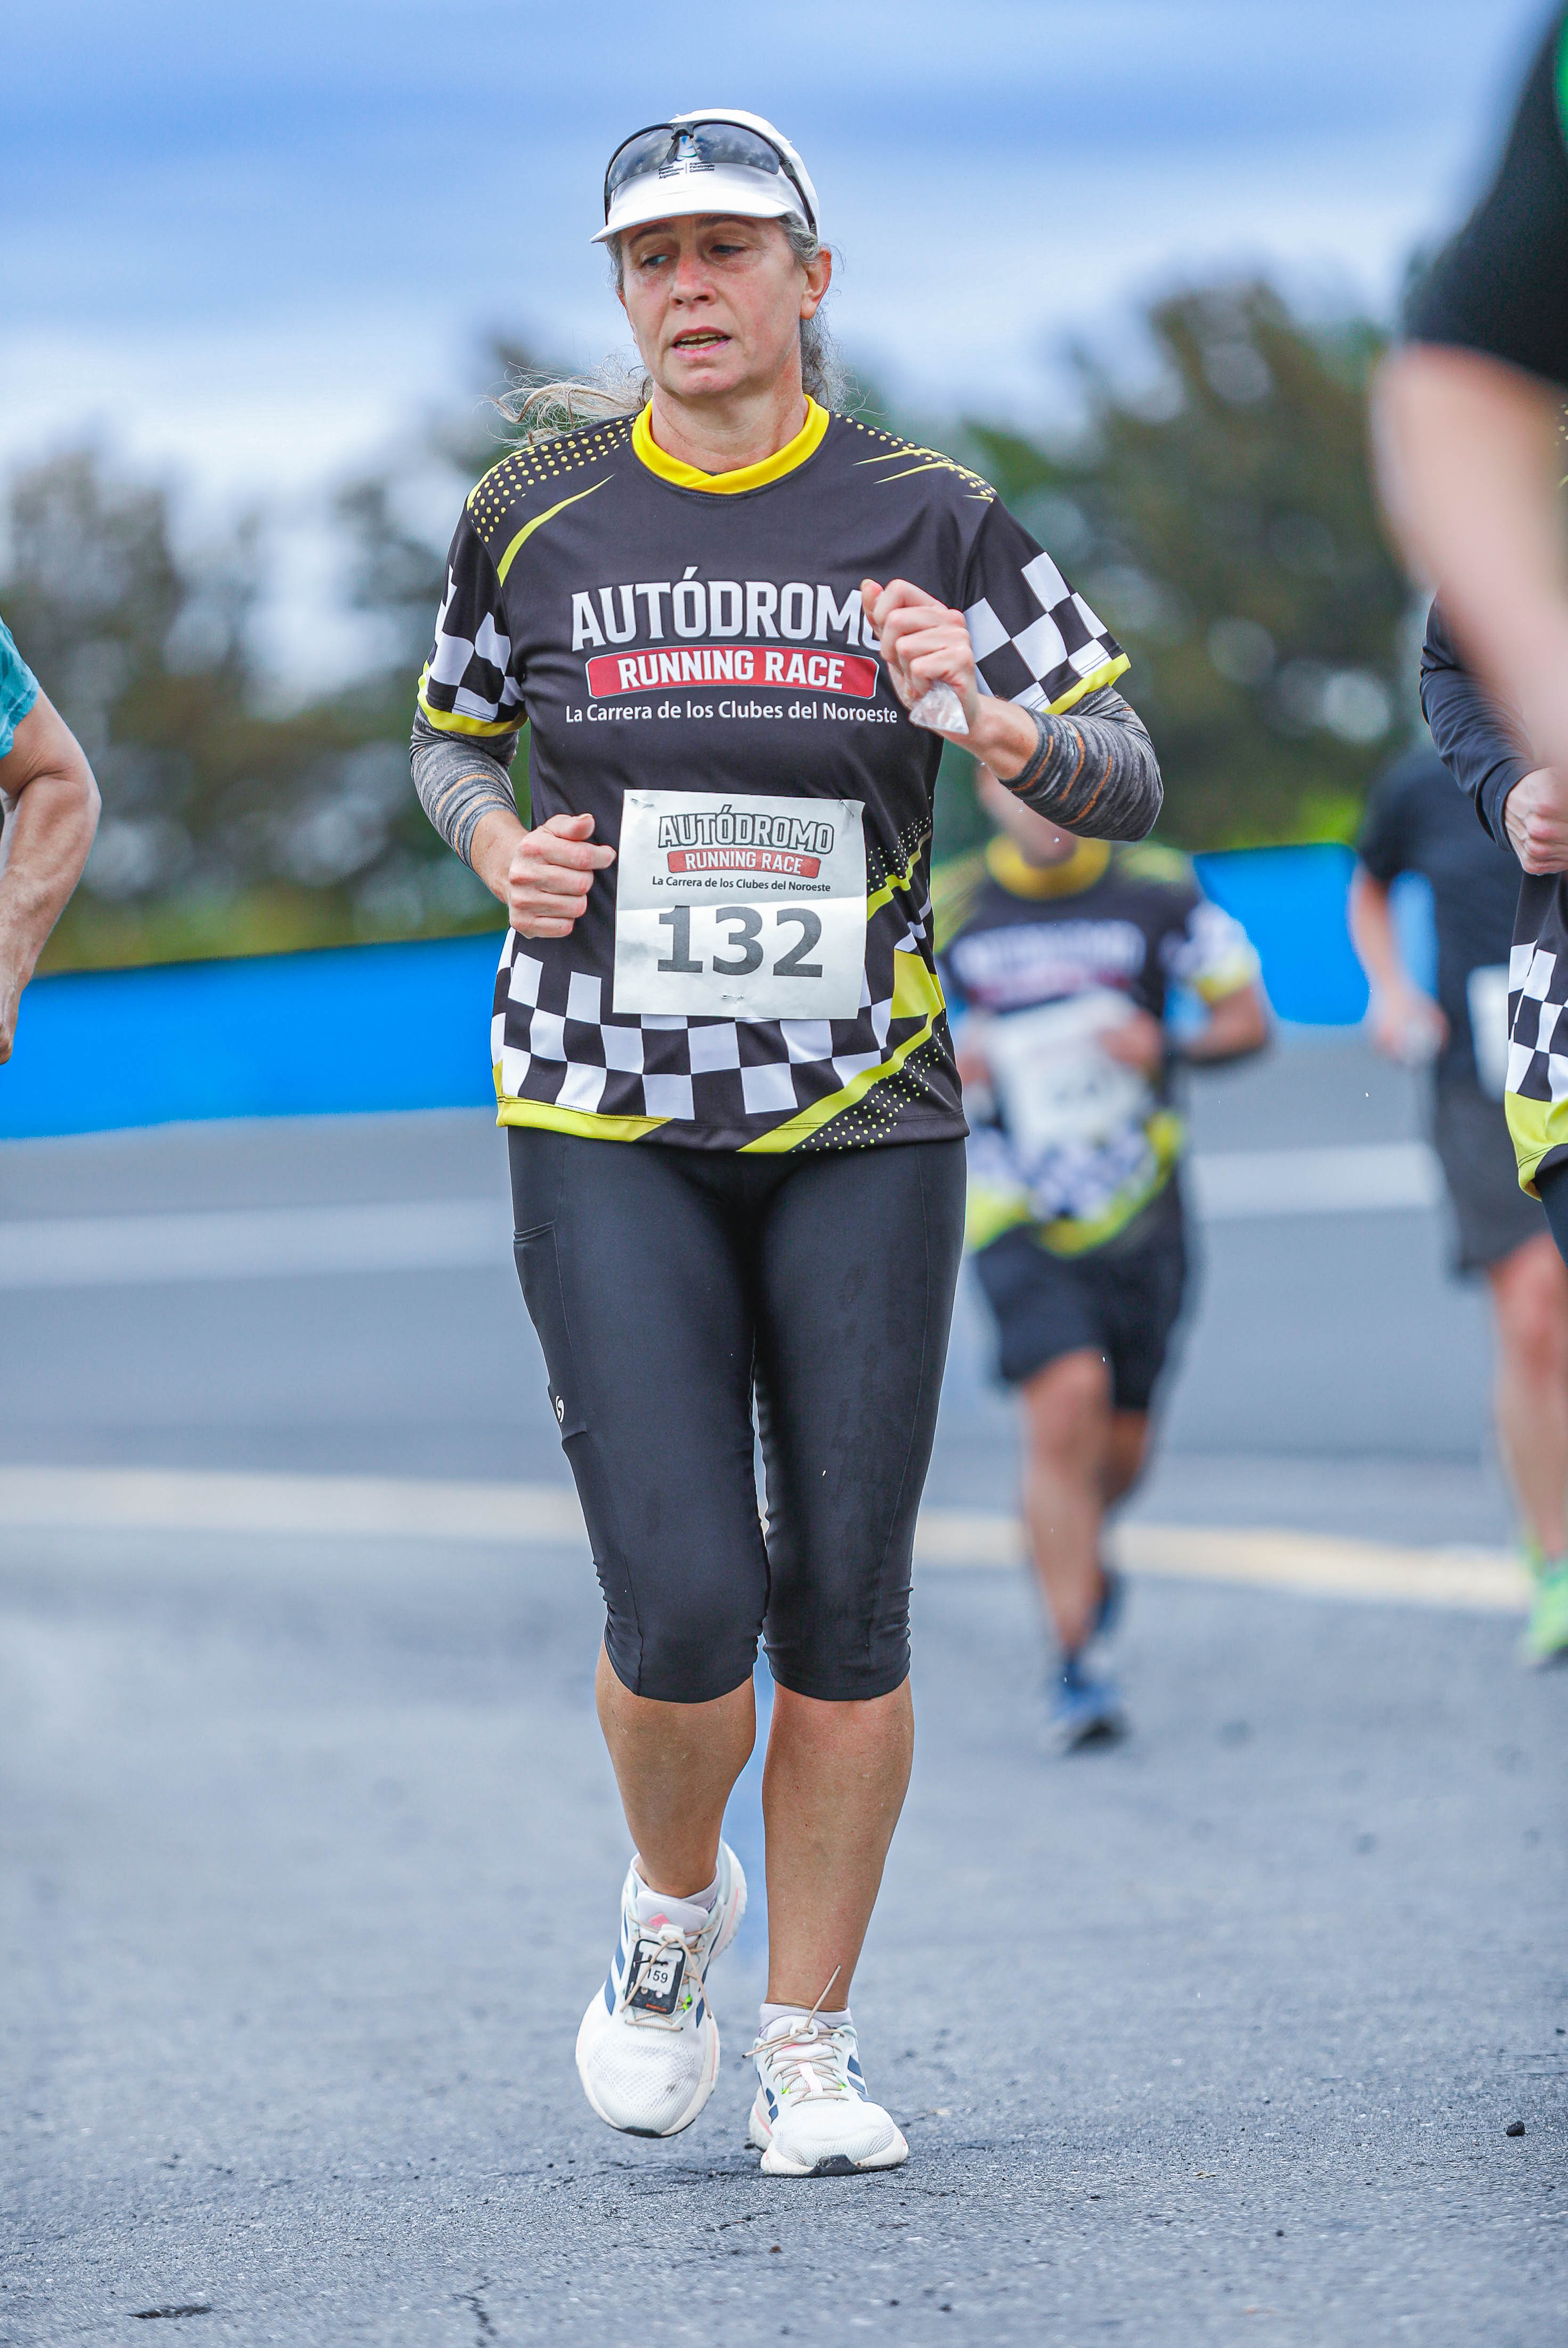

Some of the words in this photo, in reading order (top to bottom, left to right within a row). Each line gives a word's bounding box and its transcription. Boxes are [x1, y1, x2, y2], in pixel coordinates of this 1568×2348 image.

[617, 649, 755, 690] RUNNING
[765, 655, 846, 690] RACE
[566, 705, 583, 723] La
[587, 704, 652, 721] Carrera
[657, 701, 682, 719] de
[687, 701, 714, 718] los
[719, 701, 783, 719] Clubes
[788, 701, 817, 719] del
[823, 702, 897, 723] Noroeste
[658, 805, 835, 855] AUTÓDROMO
[685, 851, 756, 871] RUNNING
[761, 852, 803, 874] RACE
[652, 876, 663, 885] La
[666, 876, 702, 887] Carrera
[705, 878, 718, 888] de
[720, 878, 734, 888] los
[736, 879, 769, 890] Clubes
[771, 880, 786, 890] del
[789, 881, 831, 892] Noroeste
[657, 905, 823, 978] 132
